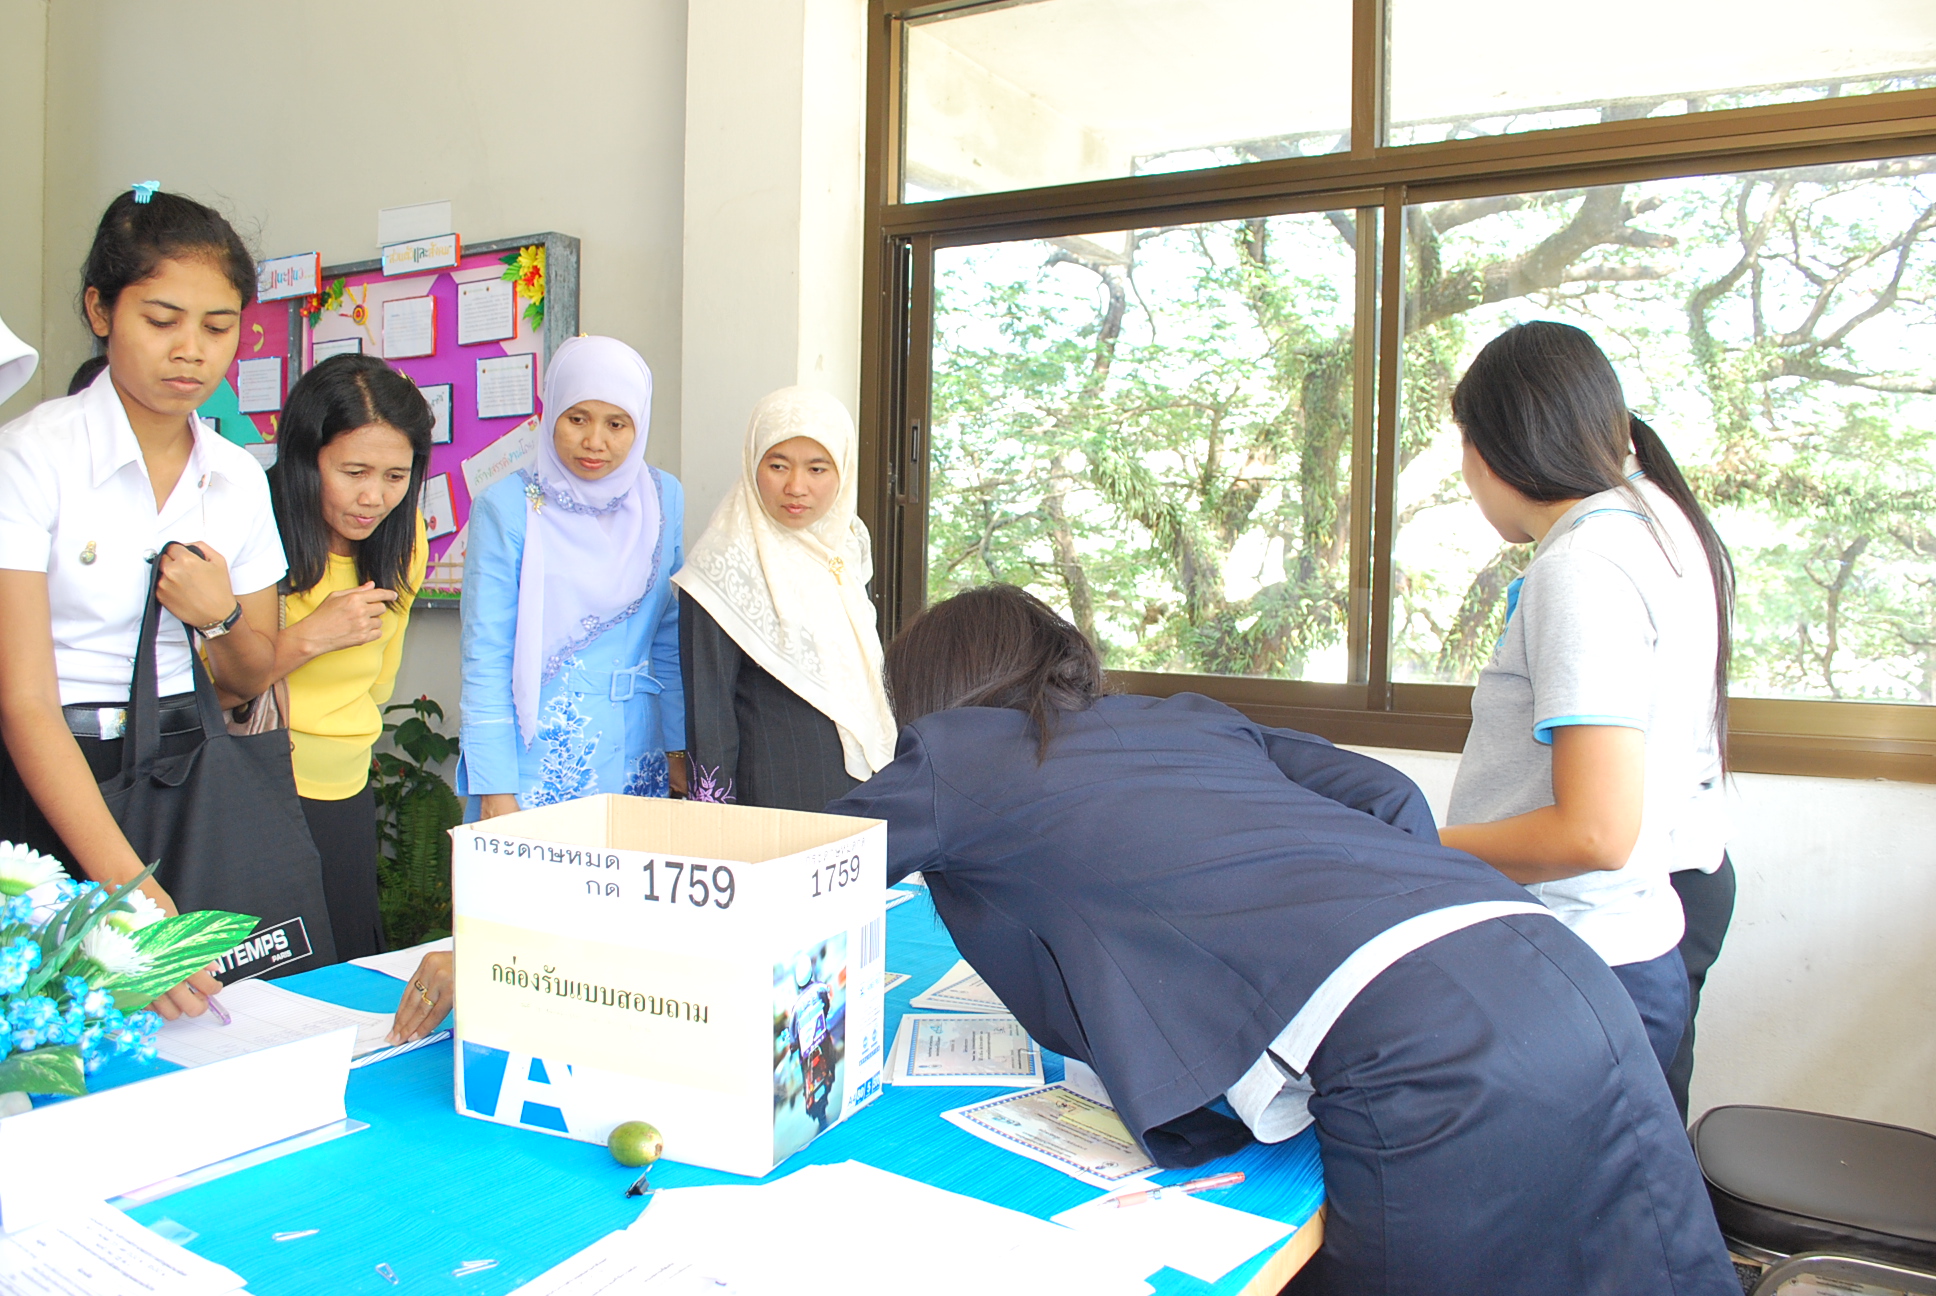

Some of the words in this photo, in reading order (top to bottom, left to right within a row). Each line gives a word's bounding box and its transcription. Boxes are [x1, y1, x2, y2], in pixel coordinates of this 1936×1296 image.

[473, 836, 620, 870] กระดาษหมด
[585, 880, 620, 898] กด
[642, 859, 736, 910] 1759
[811, 854, 860, 898] 1759
[207, 928, 289, 977] NTEMPS
[271, 949, 292, 963] PARIS
[491, 957, 709, 1024] กล่องรับแบบสอบถาม
